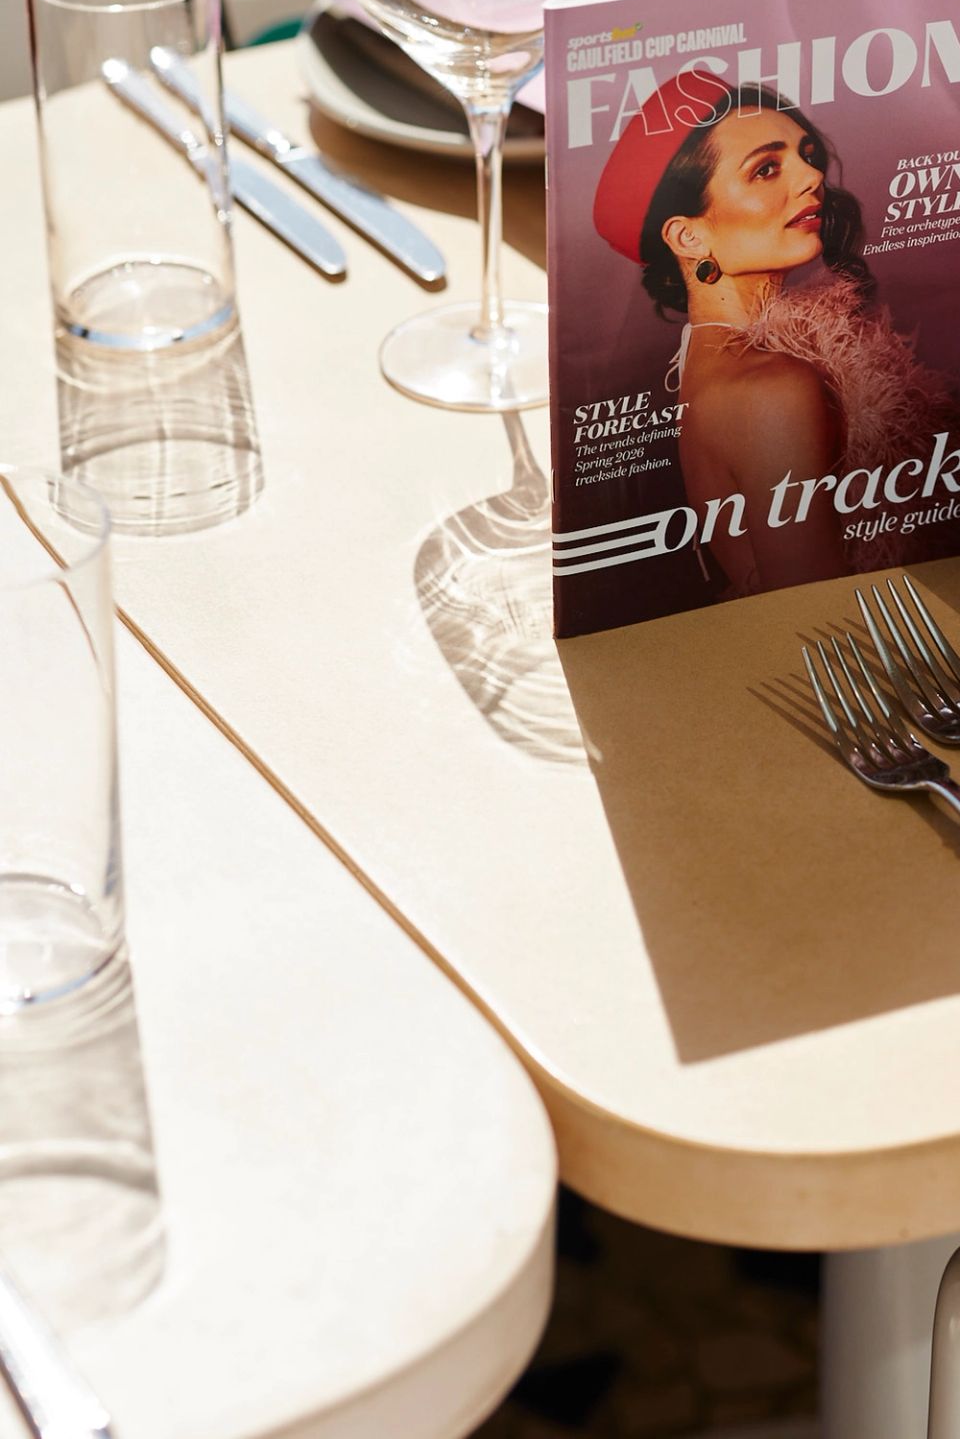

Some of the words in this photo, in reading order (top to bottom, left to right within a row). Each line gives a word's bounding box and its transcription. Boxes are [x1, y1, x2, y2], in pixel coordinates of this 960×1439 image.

[645, 35, 675, 59] CUP
[897, 154, 935, 171] BACK
[881, 225, 905, 238] Five
[863, 240, 906, 256] Endless
[573, 391, 651, 424] STYLE
[573, 403, 689, 443] FORECAST
[575, 444, 597, 457] The
[599, 435, 635, 452] trends
[636, 425, 683, 444] defining
[574, 456, 614, 473] Spring
[614, 447, 645, 464] 2026
[575, 465, 628, 487] trackside
[628, 458, 672, 477] fashion.
[655, 492, 748, 552] on
[843, 511, 899, 542] style
